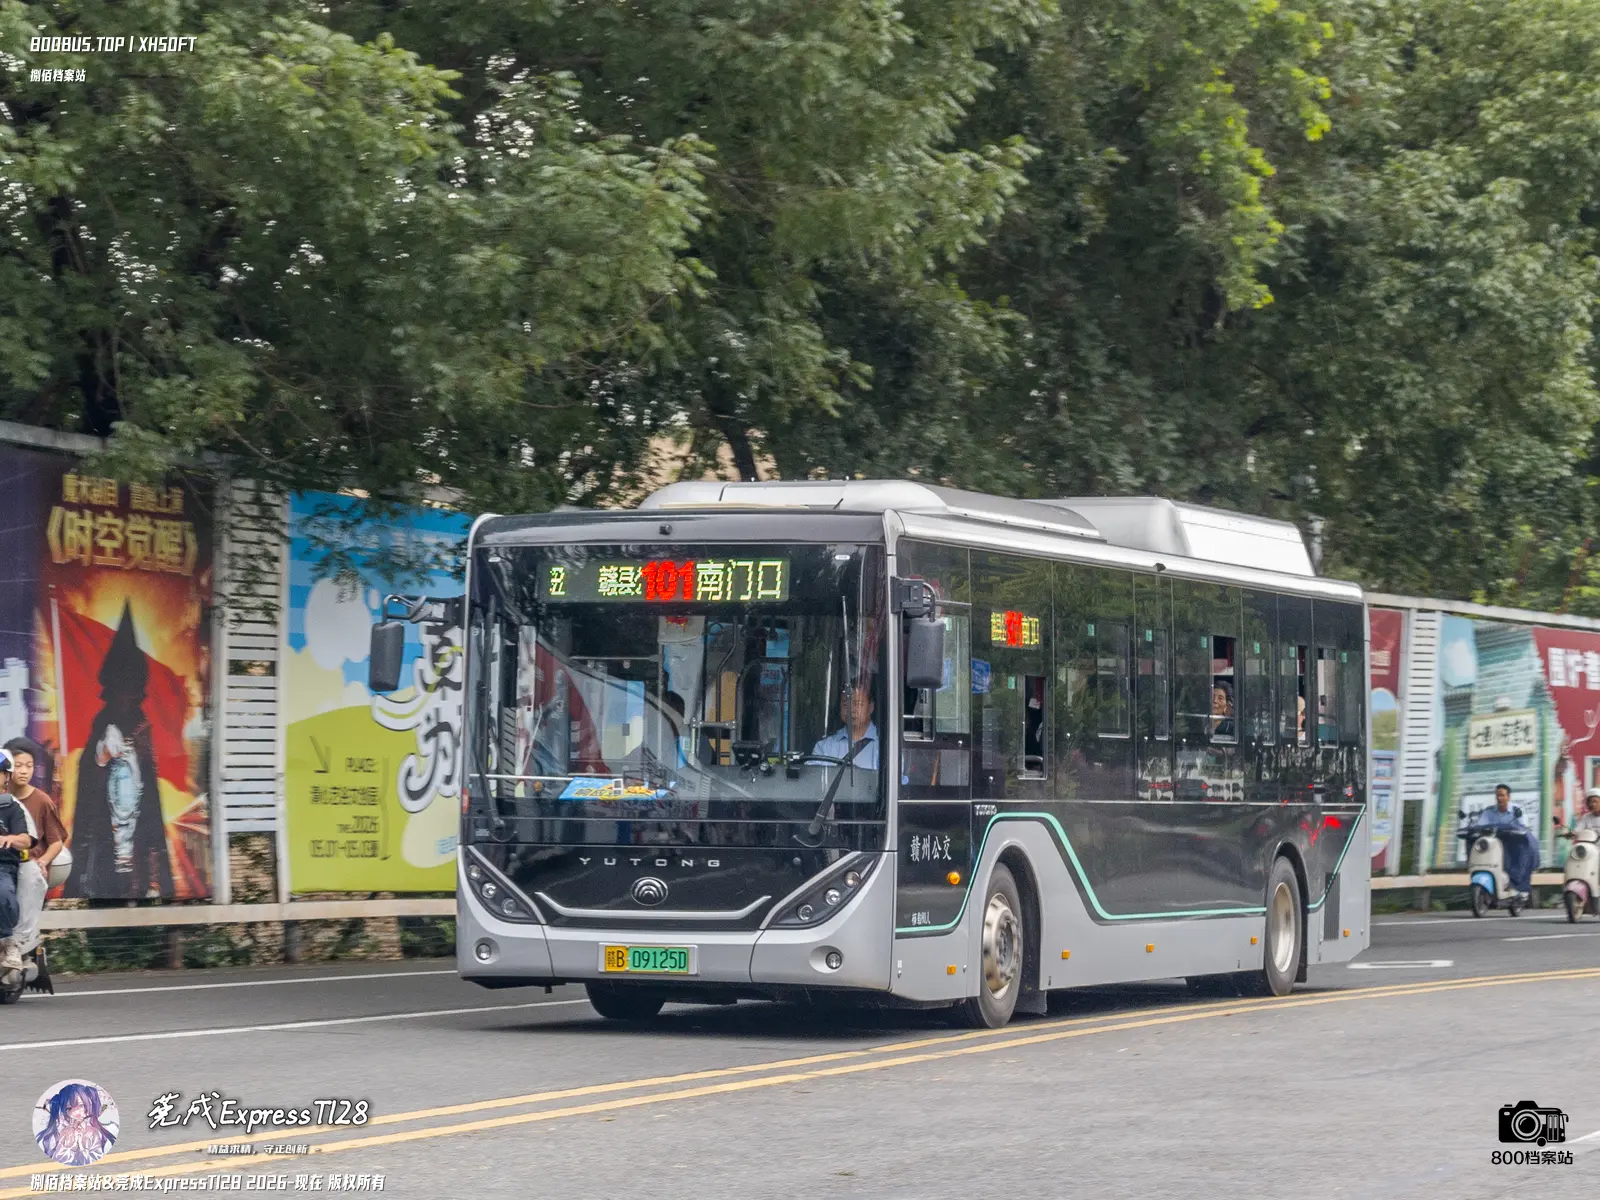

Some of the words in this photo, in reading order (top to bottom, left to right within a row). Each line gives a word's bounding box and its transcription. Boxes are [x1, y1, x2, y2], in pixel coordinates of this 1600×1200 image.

[640, 560, 695, 600] 101
[696, 559, 783, 601] 南门口
[910, 834, 952, 862] 赣州公交
[579, 857, 721, 868] YUTONG
[632, 950, 688, 970] 09125D
